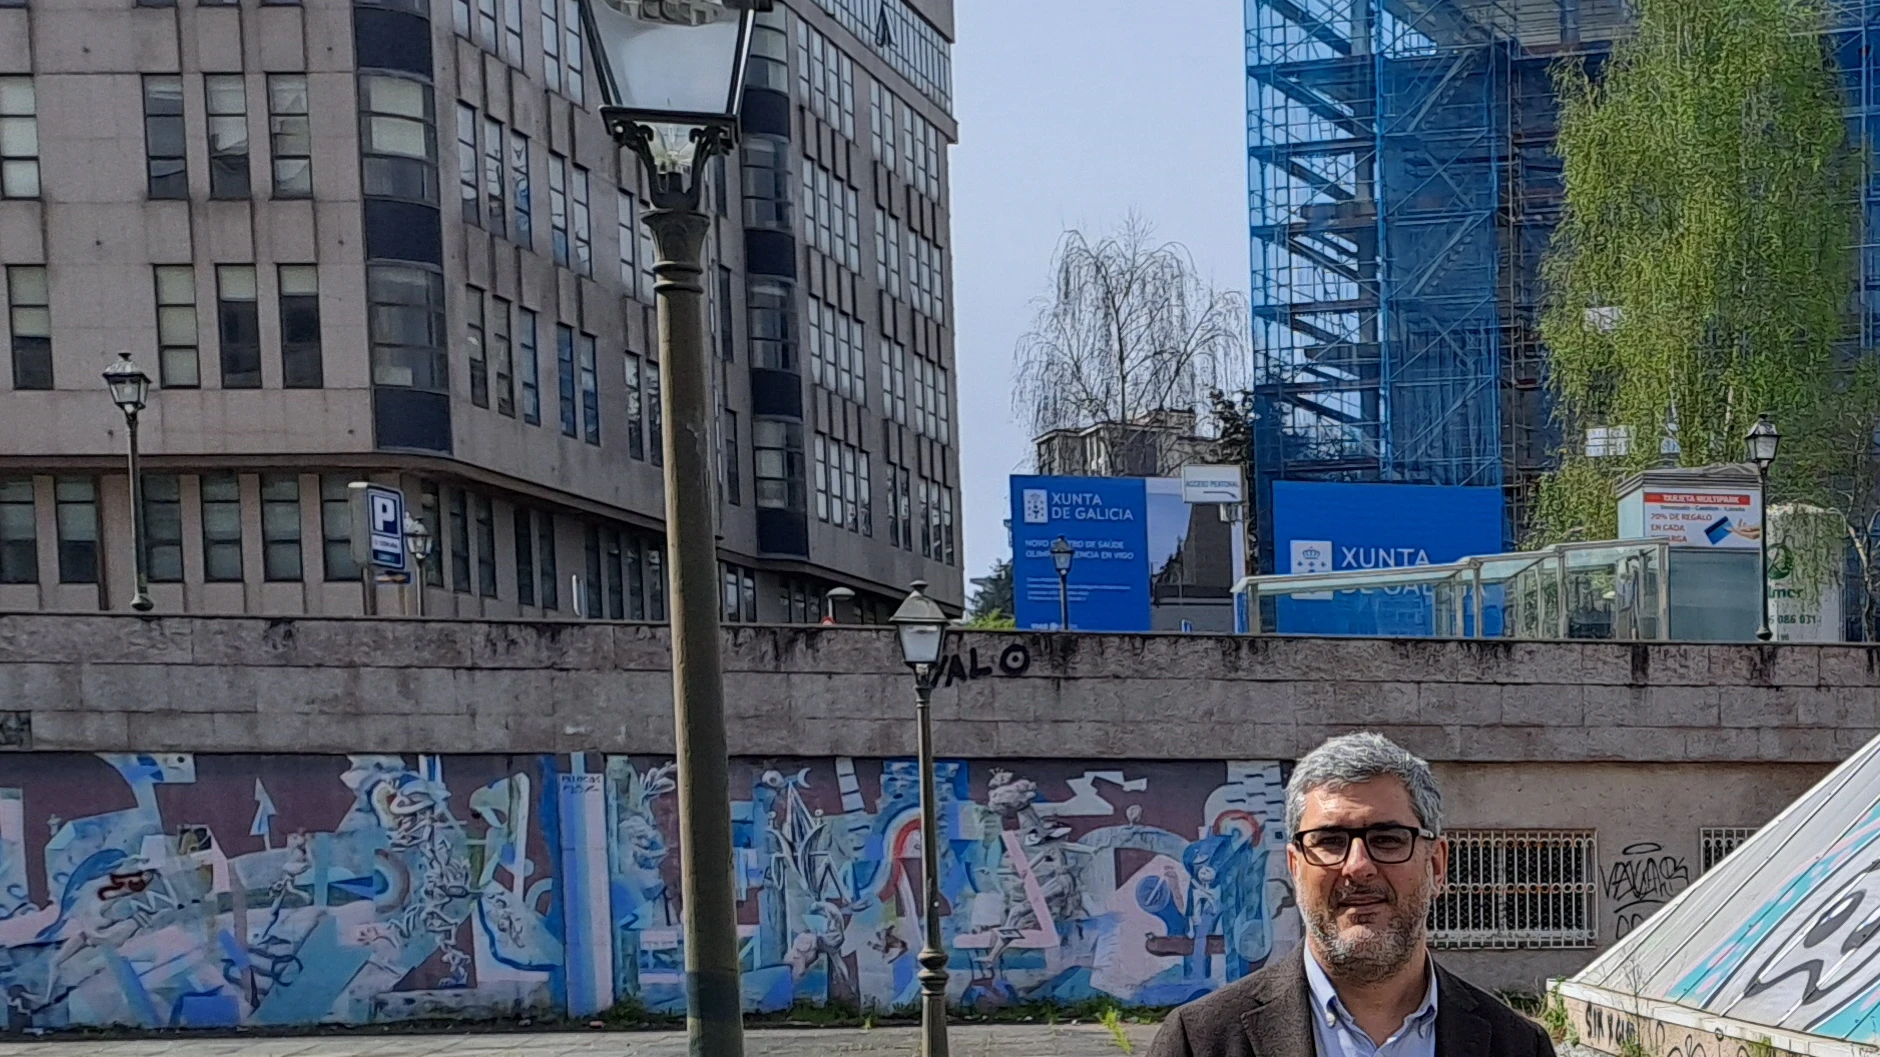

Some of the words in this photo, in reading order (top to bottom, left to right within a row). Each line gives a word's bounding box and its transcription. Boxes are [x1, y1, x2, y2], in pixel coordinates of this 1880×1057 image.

[1051, 492, 1103, 506] XUNTA
[374, 495, 396, 532] P
[1051, 507, 1071, 520] DE
[1074, 508, 1134, 521] GALICIA
[1682, 513, 1712, 521] REGALO
[1341, 546, 1431, 568] XUNTA
